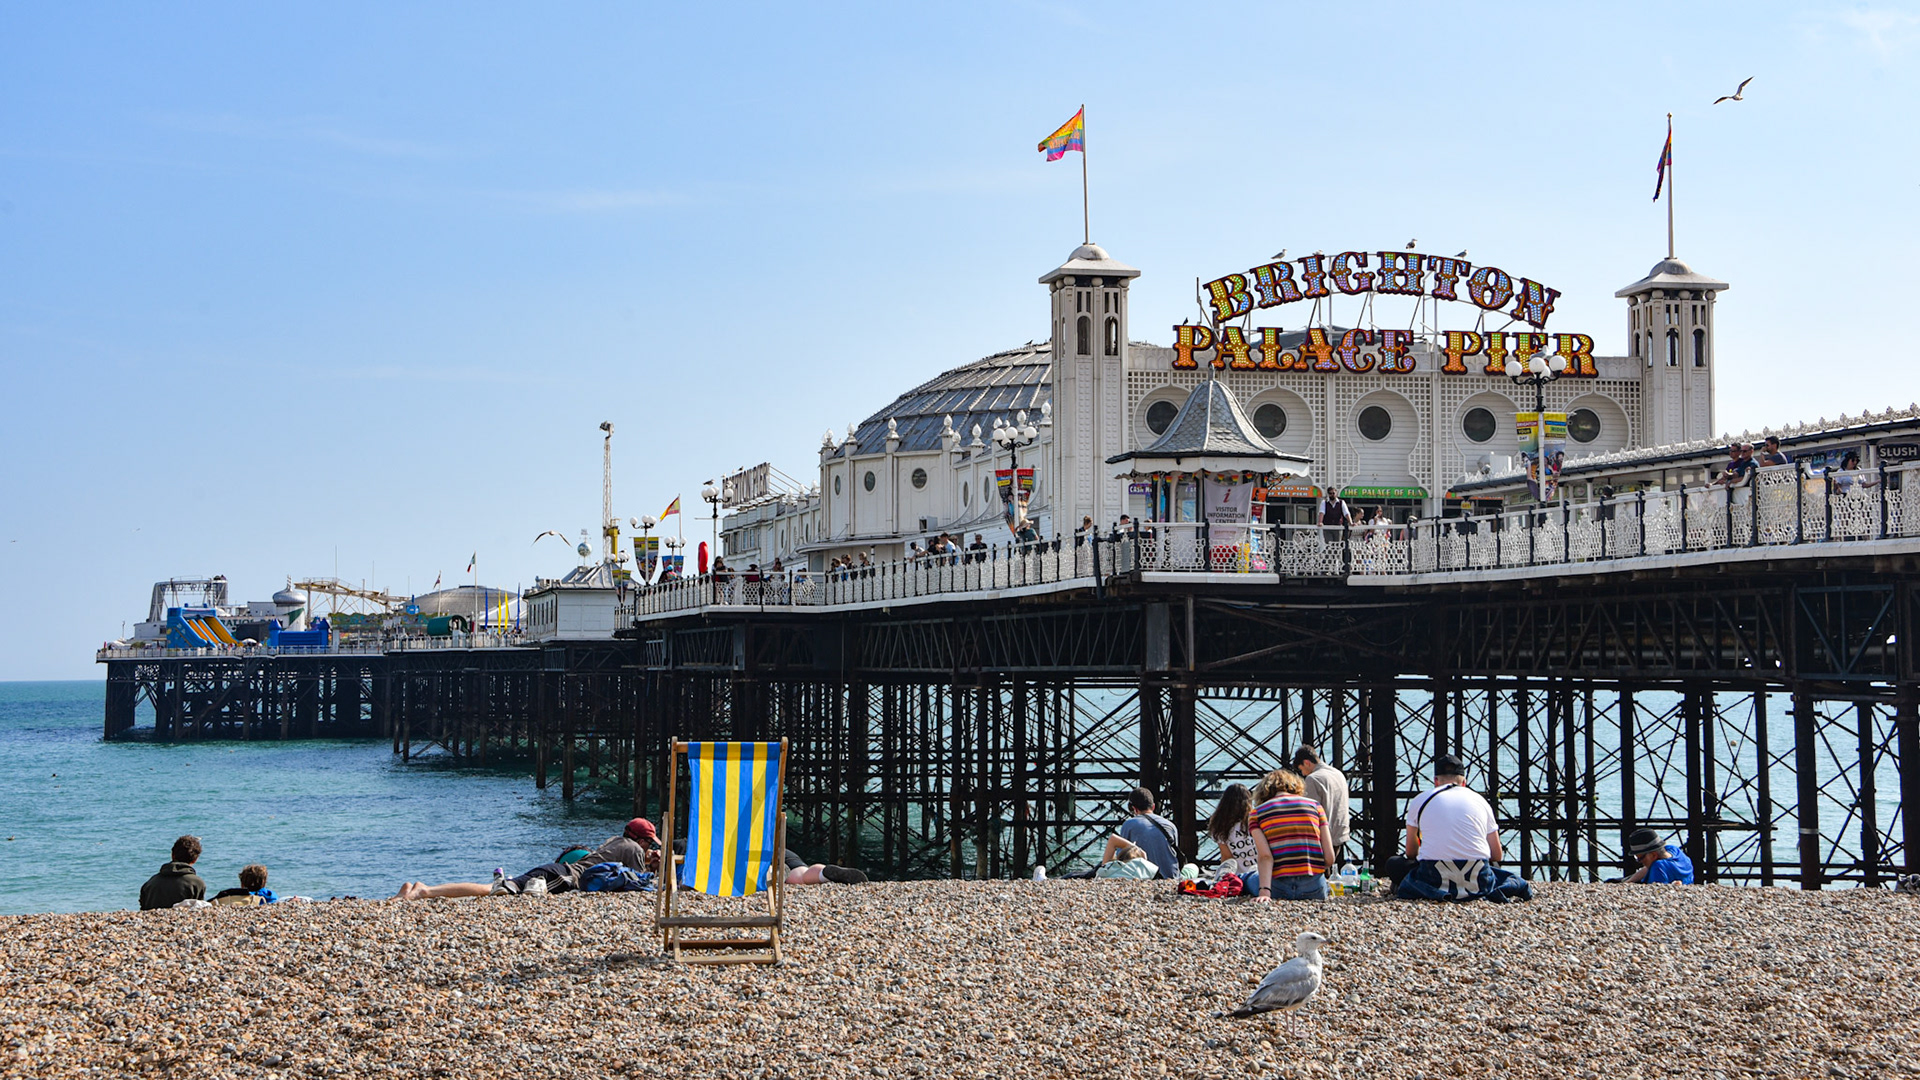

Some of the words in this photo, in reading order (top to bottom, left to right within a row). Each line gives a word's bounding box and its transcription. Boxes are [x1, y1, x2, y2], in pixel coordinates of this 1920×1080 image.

[1202, 251, 1562, 330] BRIGHTON
[1172, 325, 1417, 374] PALACE
[1441, 330, 1599, 379] PIER
[1879, 446, 1918, 457] SLUSH
[1344, 488, 1359, 497] THE
[1361, 488, 1392, 497] PALACE
[1394, 488, 1405, 497] OF
[1407, 488, 1424, 497] FUN
